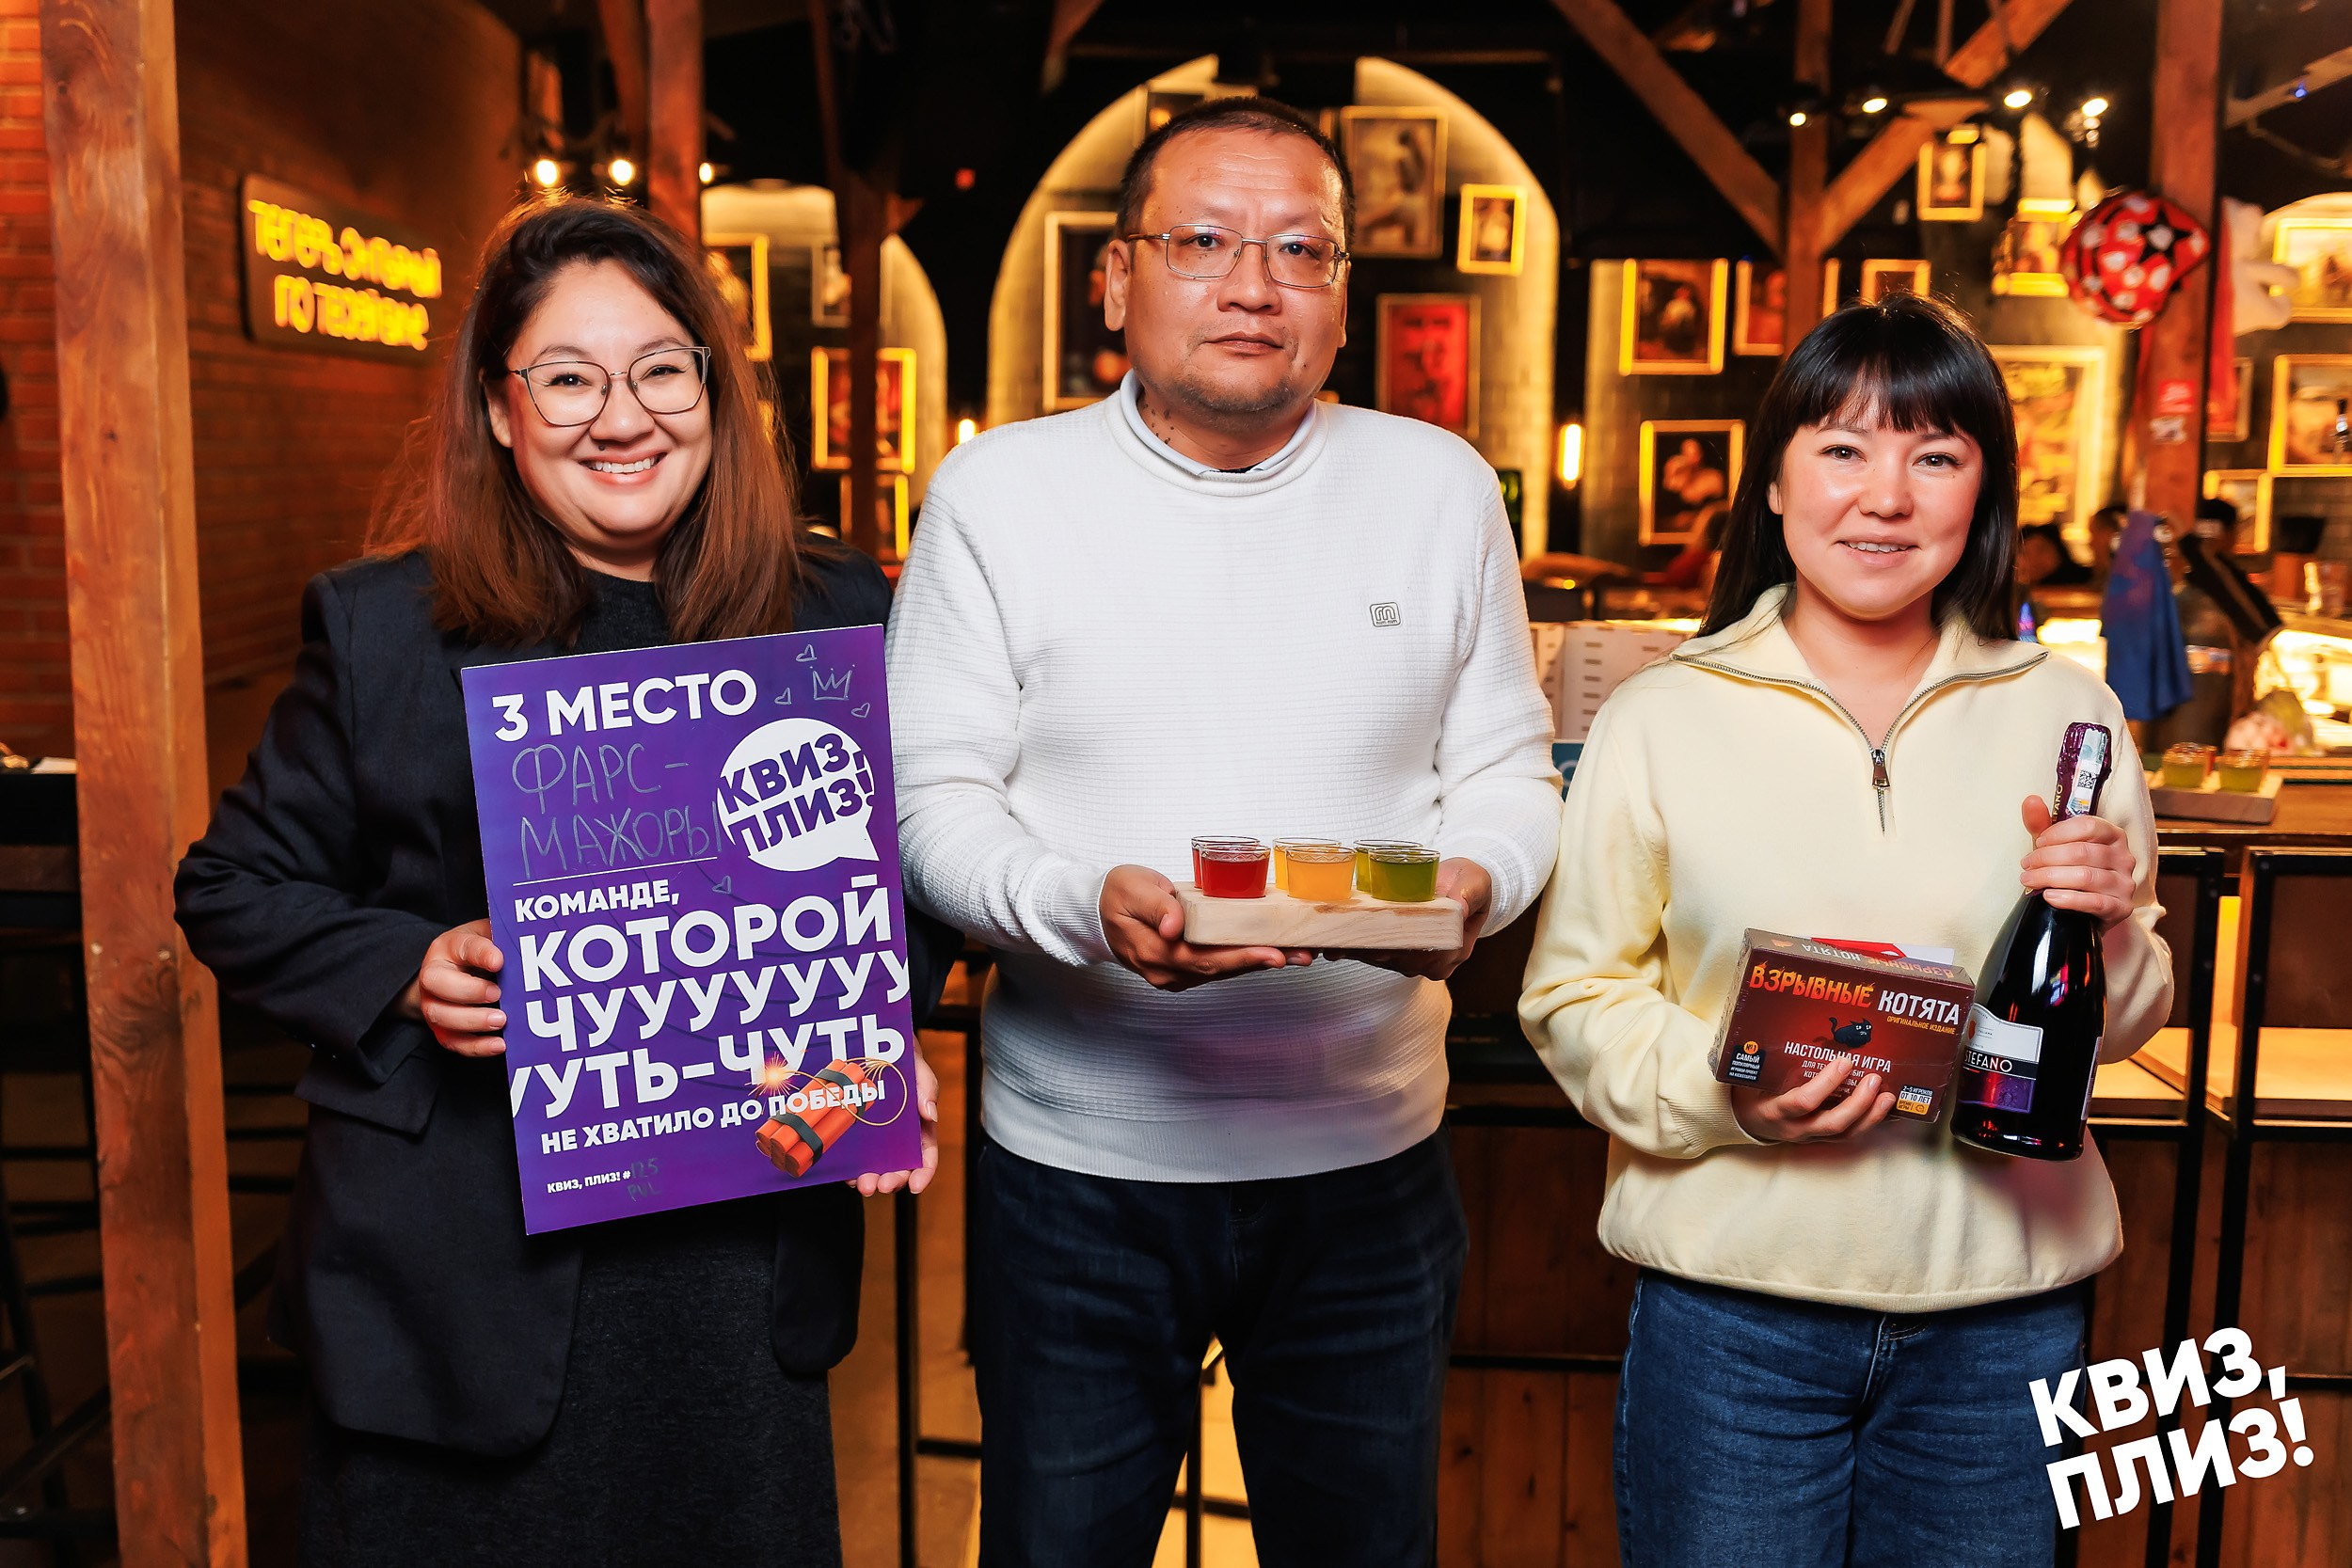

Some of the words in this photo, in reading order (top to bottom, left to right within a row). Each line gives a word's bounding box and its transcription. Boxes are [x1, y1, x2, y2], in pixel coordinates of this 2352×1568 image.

[491, 693, 529, 742] 3
[545, 669, 757, 736] МЕСТО
[519, 800, 723, 879] МАЖОРЫ
[514, 879, 680, 923] КОМАНДЕ,
[518, 874, 892, 992] КОТОРОЙ
[1802, 942, 1861, 961] КОТЯТА
[1749, 961, 1876, 1008] ВЗРЫВНЫЕ
[1878, 990, 1961, 1025] КОТЯТА
[1886, 1016, 1929, 1031] ОРИГИНАЛЬНОЕ
[1930, 1022, 1957, 1036] ИЗДАНИЕ
[1736, 1053, 1760, 1064] САМЫЙ
[1802, 1060, 1816, 1069] ДЛЯ
[1861, 1055, 1892, 1073] ИГРА
[1964, 1049, 2012, 1073] STEFANO
[1804, 1070, 1819, 1079] КОТ
[1918, 1096, 1931, 1104] ЛЕТ
[541, 1130, 579, 1155] НЕ
[582, 1107, 715, 1148] ХВАТИЛО
[720, 1100, 763, 1127] ДО
[769, 1080, 886, 1117] ПОБЕДЫ
[547, 1176, 583, 1195] КВИЗ,
[584, 1171, 621, 1189] ПЛИЗ!
